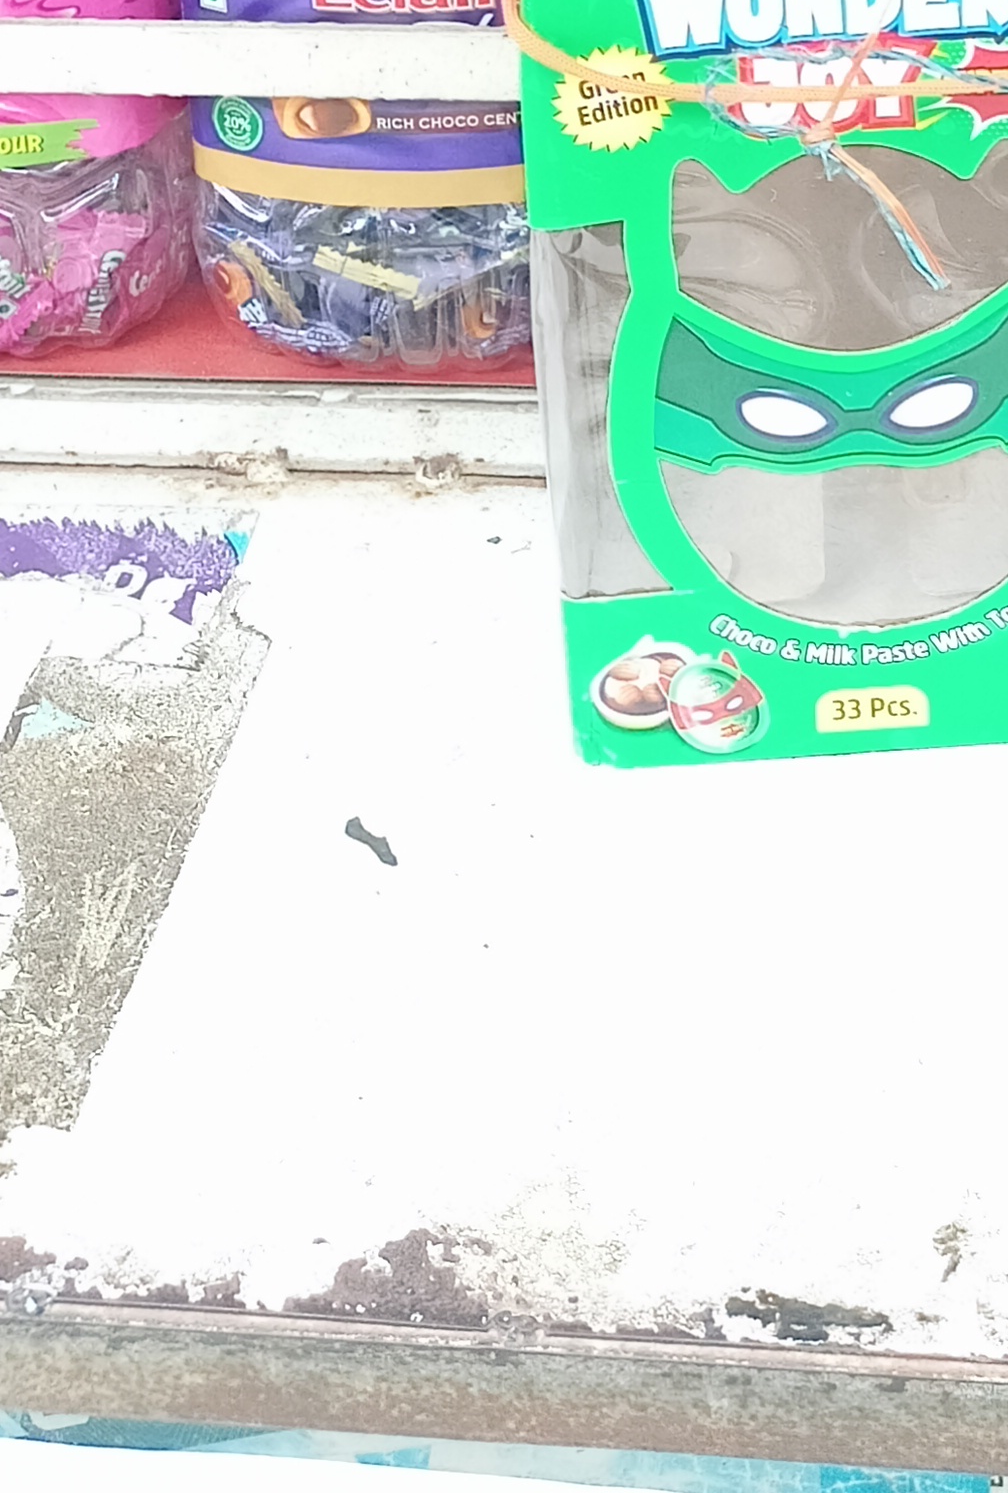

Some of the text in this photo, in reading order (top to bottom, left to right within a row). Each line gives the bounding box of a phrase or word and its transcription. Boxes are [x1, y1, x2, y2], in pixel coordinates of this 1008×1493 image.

[376, 111, 521, 130] RICH CHOCO CEN
[578, 94, 660, 127] Edition
[709, 613, 778, 656] Choco
[780, 639, 801, 662] &
[805, 643, 857, 666] Milk
[861, 640, 930, 666] Paste
[929, 621, 991, 654] With
[832, 697, 918, 721] 33 Pcs.
